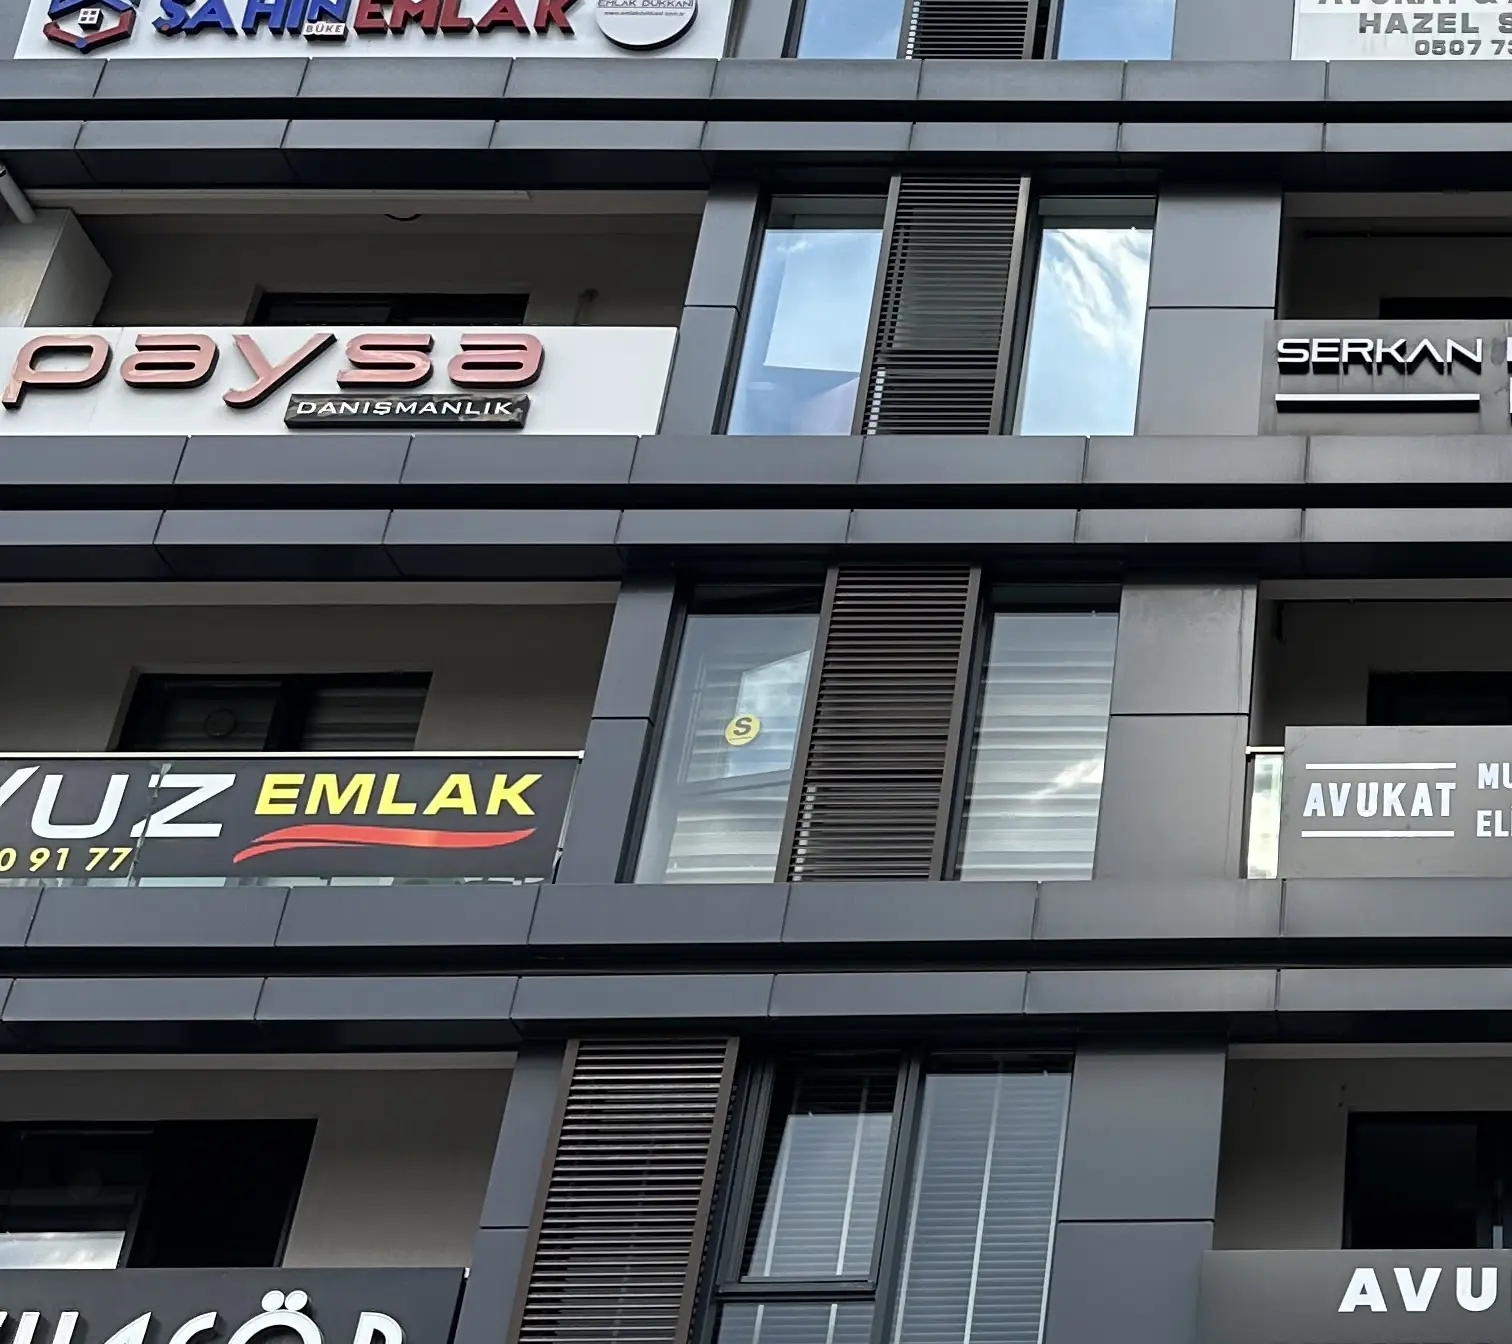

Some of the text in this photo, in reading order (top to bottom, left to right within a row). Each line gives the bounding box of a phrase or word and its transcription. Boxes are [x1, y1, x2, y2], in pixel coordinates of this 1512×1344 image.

[598, 0, 637, 7] EMLAK
[305, 21, 343, 34] BÜKE
[1358, 12, 1480, 34] HAZEL
[1415, 39, 1482, 56] 0507
[1277, 338, 1483, 367] SERKAN
[1, 333, 546, 410] paysa
[296, 400, 514, 417] DANIŞMANLIK
[254, 773, 543, 816] EMLAK
[1303, 782, 1457, 818] AVUKAT
[29, 848, 68, 871] 91
[85, 847, 132, 871] 77
